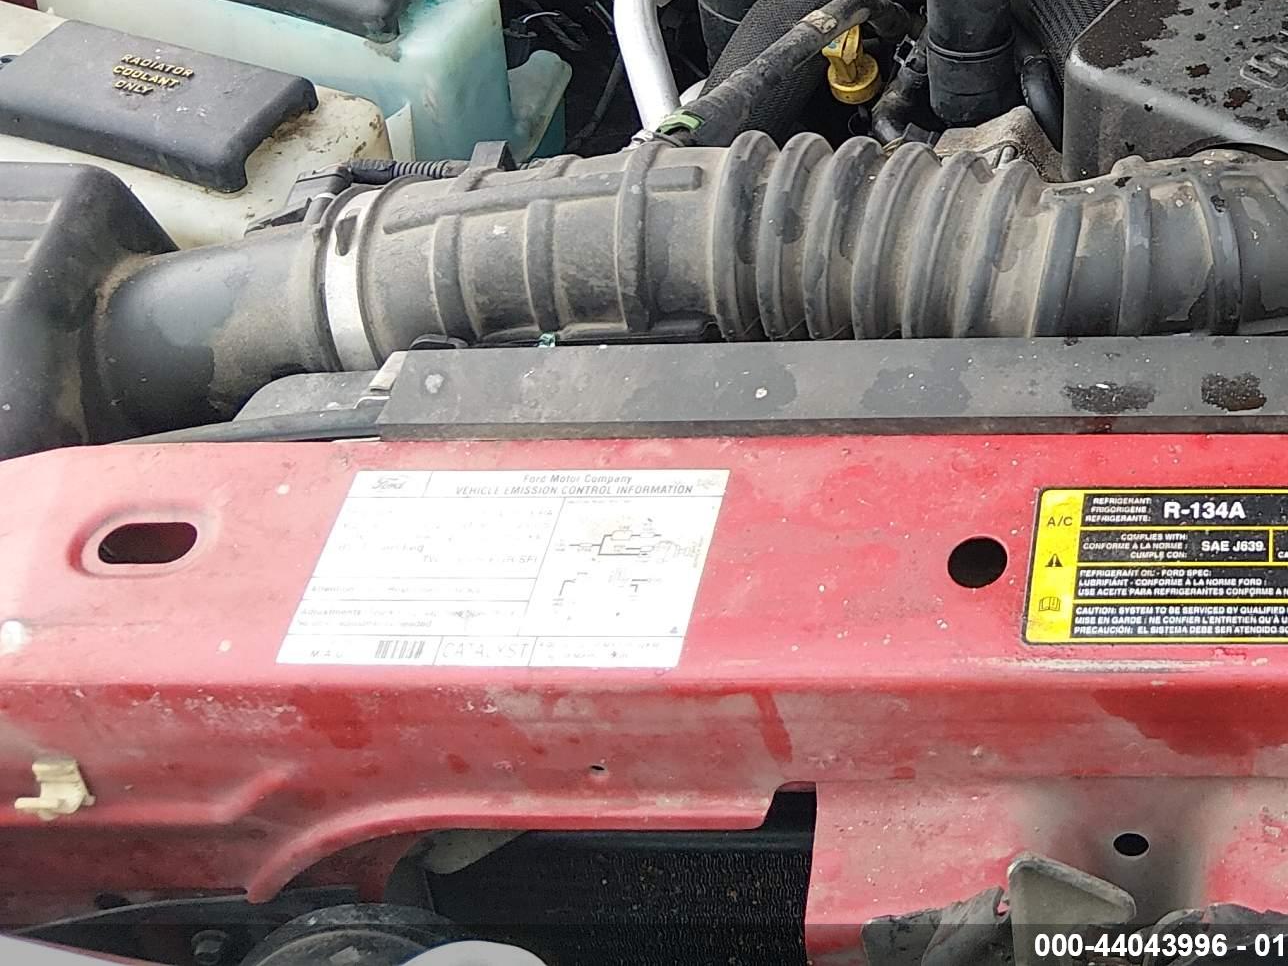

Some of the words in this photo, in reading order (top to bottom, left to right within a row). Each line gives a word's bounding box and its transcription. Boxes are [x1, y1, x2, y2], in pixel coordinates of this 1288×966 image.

[121, 54, 194, 78] RADIATOR
[113, 66, 180, 87] COOLANT
[114, 80, 154, 95] ONLY
[522, 474, 549, 484] Ford
[551, 474, 580, 484] Motor
[585, 474, 632, 485] Company
[455, 485, 500, 495] VEHICLE
[504, 485, 558, 495] EMISSION
[561, 485, 613, 495] CONTROL
[616, 484, 694, 495] INFORMATION
[1164, 502, 1246, 519] R-134A
[1047, 516, 1072, 526] A/C
[1201, 541, 1230, 551] SAE
[1078, 588, 1095, 596] USE
[1074, 616, 1096, 624] MISE
[1098, 616, 1109, 624] EN
[1111, 616, 1142, 624] GARDE
[1149, 616, 1161, 624] NE
[1163, 616, 1200, 624] CONFIER
[1137, 626, 1149, 634] EL
[1150, 626, 1188, 634] SISTEMA
[1189, 626, 1212, 634] DEBE
[1215, 626, 1233, 634] SER
[1234, 626, 1277, 634] ATENDIDO
